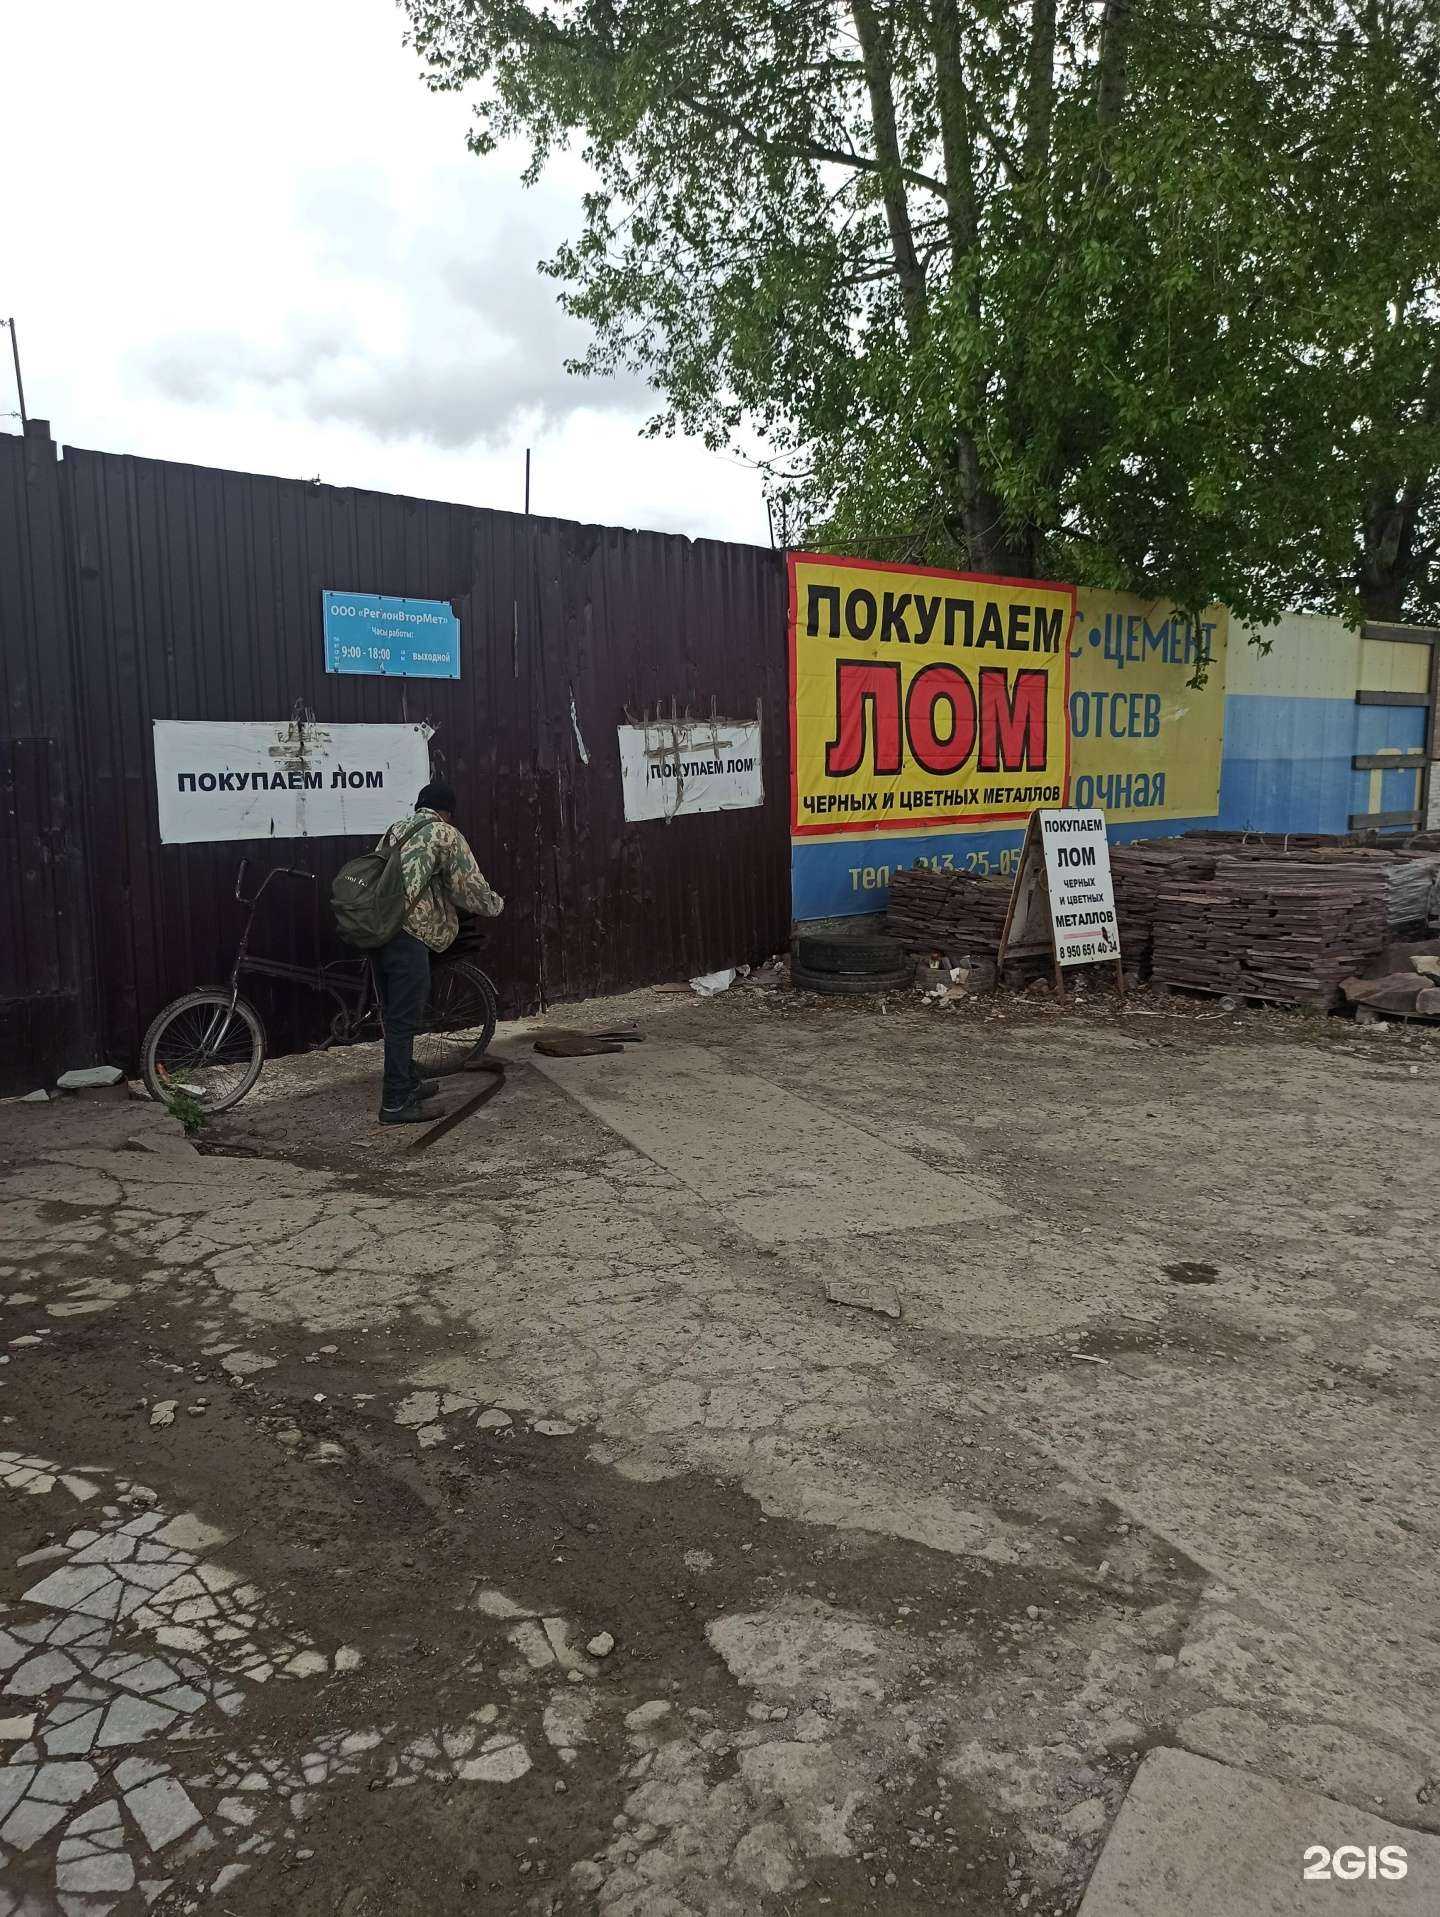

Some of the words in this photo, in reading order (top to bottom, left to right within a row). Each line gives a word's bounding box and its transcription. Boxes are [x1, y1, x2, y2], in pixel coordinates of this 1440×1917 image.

[331, 605, 356, 617] ООО
[807, 584, 1064, 653] ПОКУПАЕМ
[371, 626, 388, 637] Часы
[341, 646, 361, 658] 9:00
[367, 647, 391, 660] 18:00
[412, 651, 450, 664] выходной
[825, 658, 1049, 778] ЛОМ
[650, 759, 724, 779] ПОКУПАЕМ
[726, 758, 753, 774] ЛОМ
[177, 771, 323, 792] ПОКУПАЕМ
[330, 771, 383, 790] ЛОМ
[803, 792, 878, 814] ЧЕРНЫХ
[882, 792, 894, 809] И
[899, 788, 979, 811] ЦВЕТНЫХ
[983, 786, 1060, 805] МЕТАЛЛОВ
[1068, 772, 1165, 810] очная
[1045, 819, 1103, 833] ПОКУПАЕМ
[1057, 847, 1096, 868] ЛОМ
[1064, 878, 1096, 889] ЧЕРНЫХ
[1059, 896, 1066, 905] И
[1067, 893, 1104, 907] ЦВЕТНЫХ
[1056, 911, 1114, 928] МЕТАЛЛОВ
[1060, 946, 1066, 959] 8
[1067, 945, 1081, 958] 950
